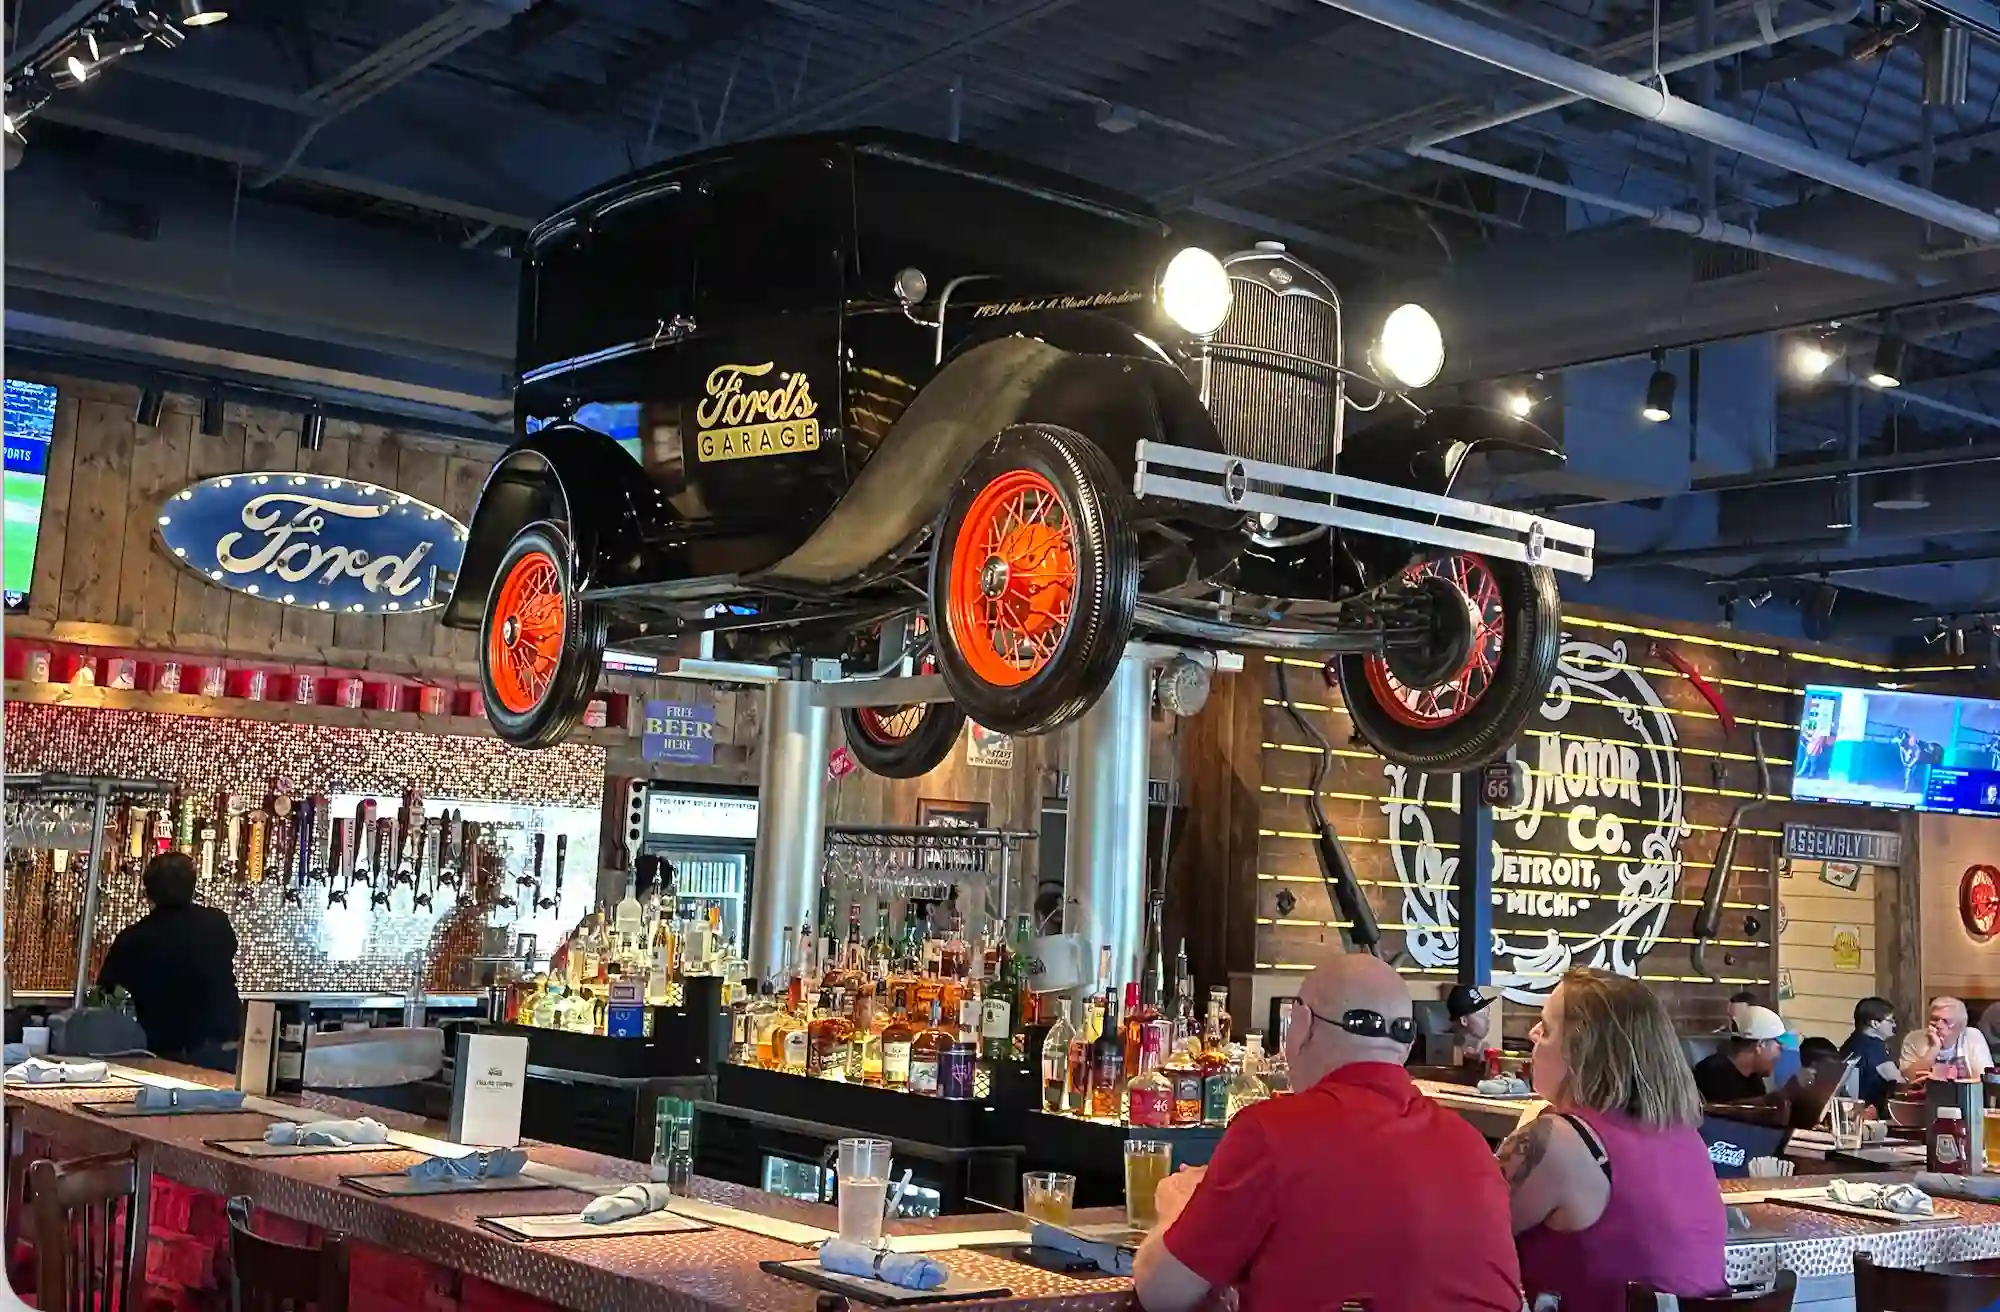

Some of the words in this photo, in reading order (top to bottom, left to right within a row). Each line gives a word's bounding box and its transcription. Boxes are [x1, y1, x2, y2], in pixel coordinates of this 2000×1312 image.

[974, 303, 1006, 318] 1931
[1005, 301, 1045, 316] Model
[696, 361, 818, 428] Ford's
[701, 424, 815, 457] GARAGE
[216, 493, 433, 597] Ford
[666, 706, 693, 717] FREE
[646, 718, 713, 739] BEER
[664, 738, 693, 751] HERE
[1487, 779, 1509, 798] 66
[1515, 731, 1641, 839] MOTOR
[1789, 829, 1862, 857] ASSEMBLY
[1867, 836, 1897, 860] LINE
[1153, 1099, 1168, 1112] 46
